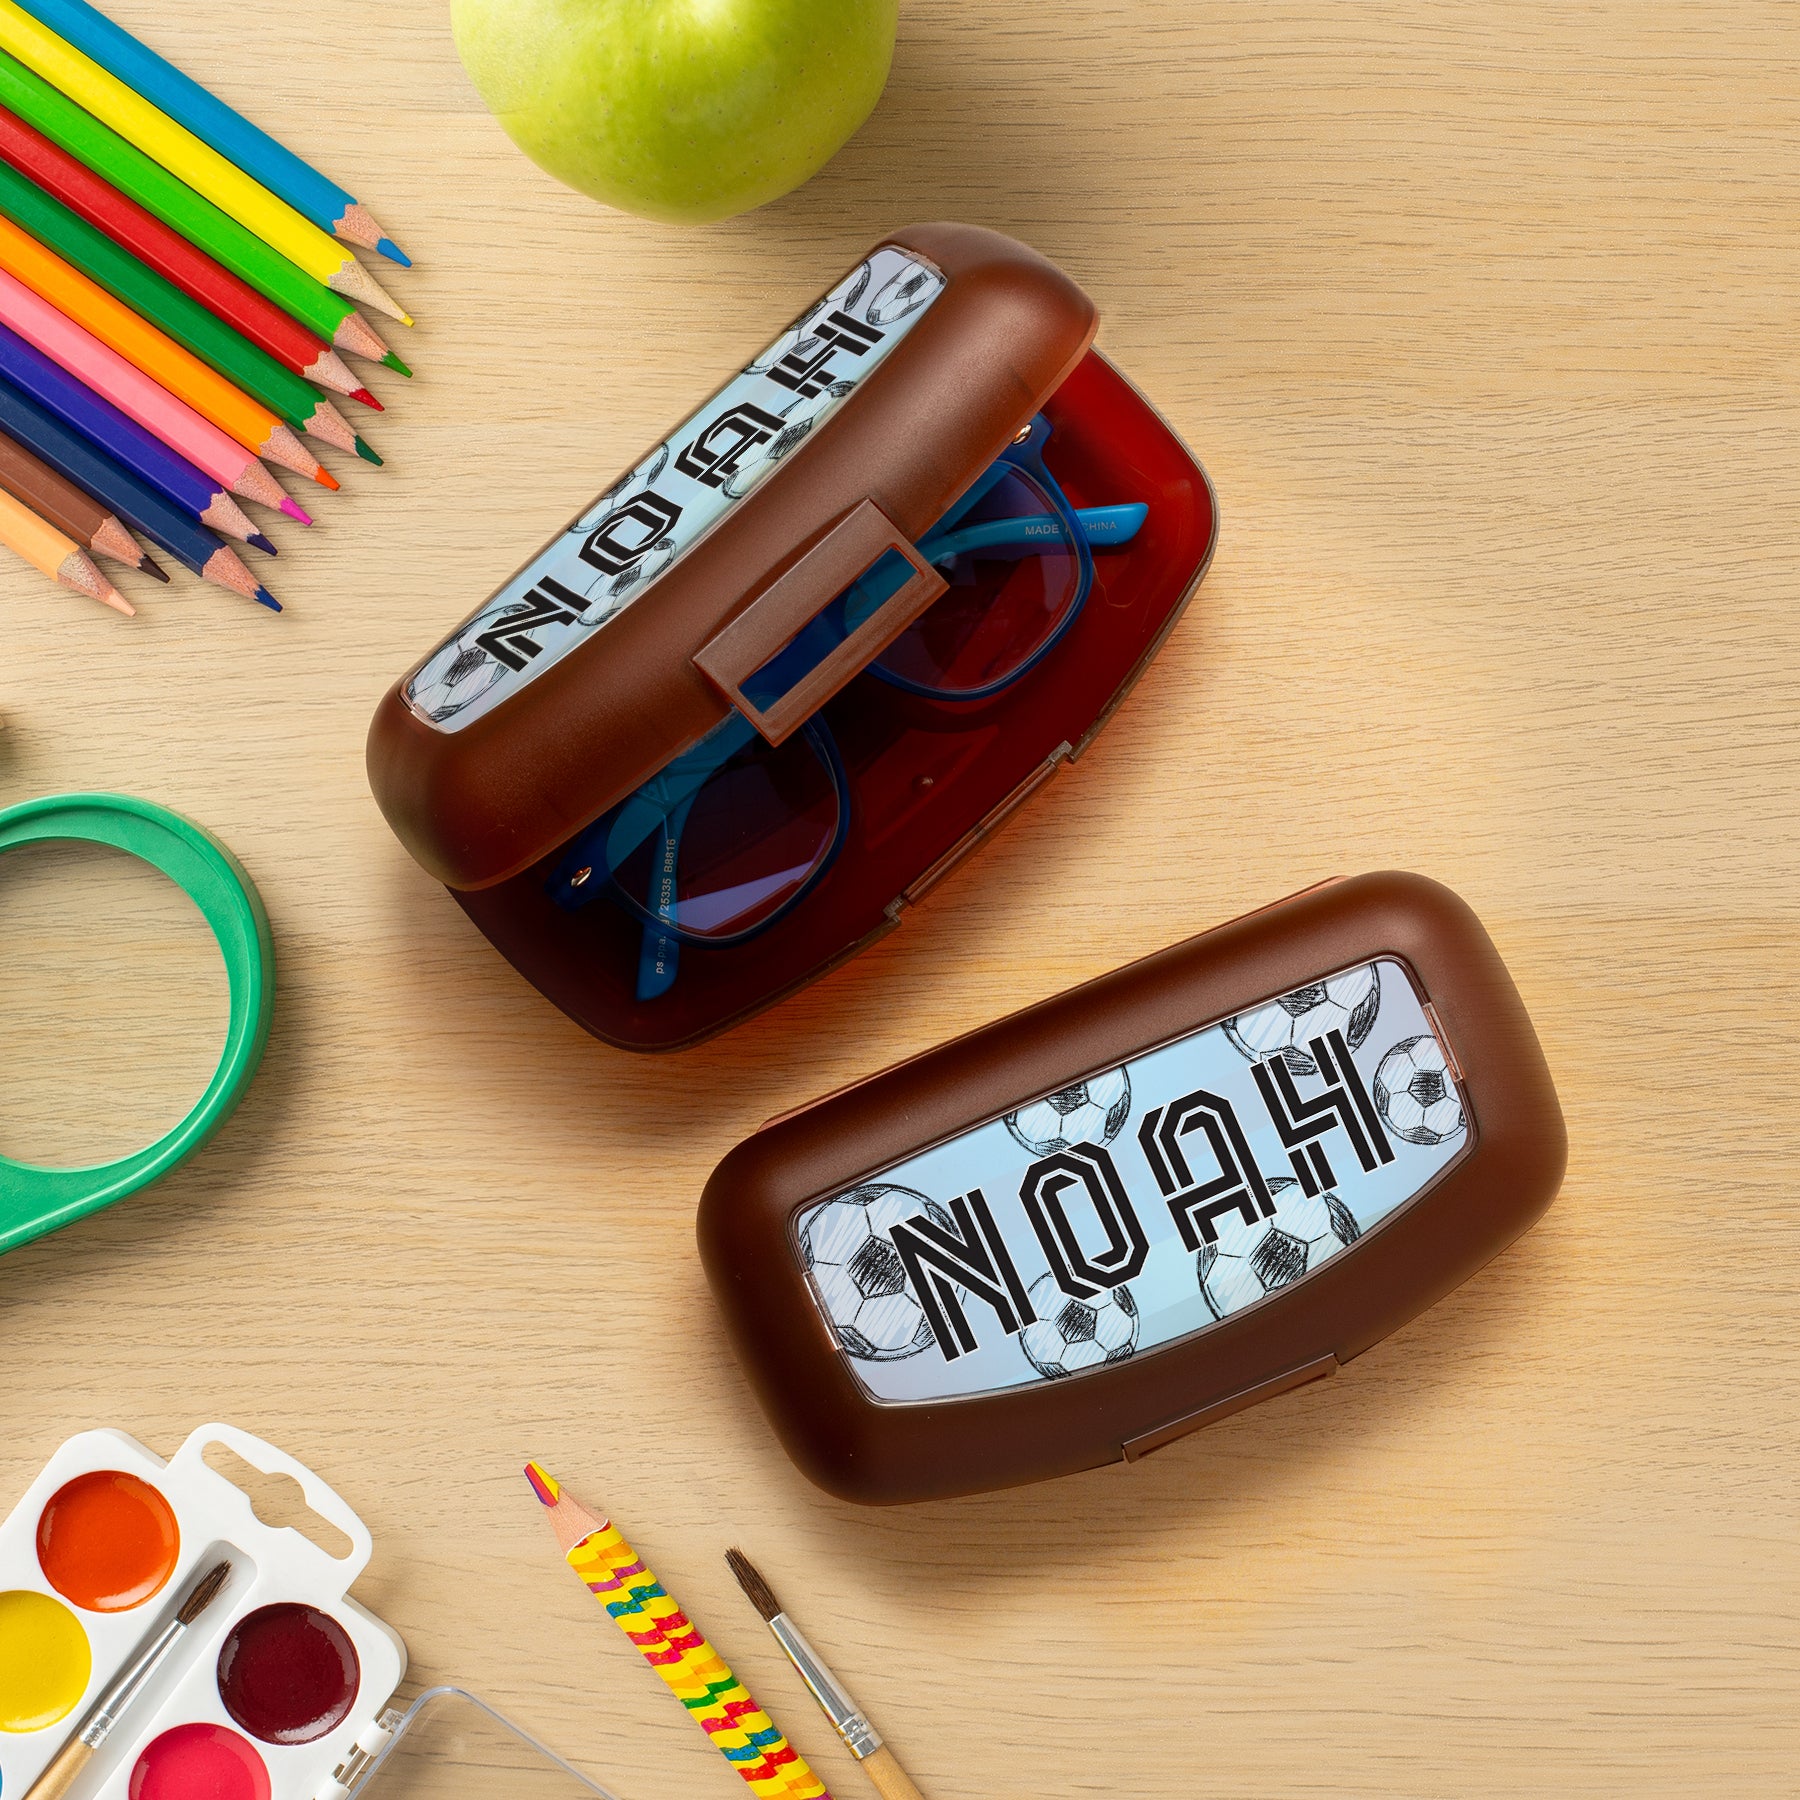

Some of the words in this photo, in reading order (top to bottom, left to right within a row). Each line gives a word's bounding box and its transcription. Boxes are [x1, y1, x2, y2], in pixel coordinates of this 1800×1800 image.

[474, 310, 886, 673] NOAH
[1025, 524, 1059, 535] MADE
[1082, 521, 1117, 532] CHINA
[664, 838, 676, 873] B8816
[889, 1028, 1398, 1364] NOAH
